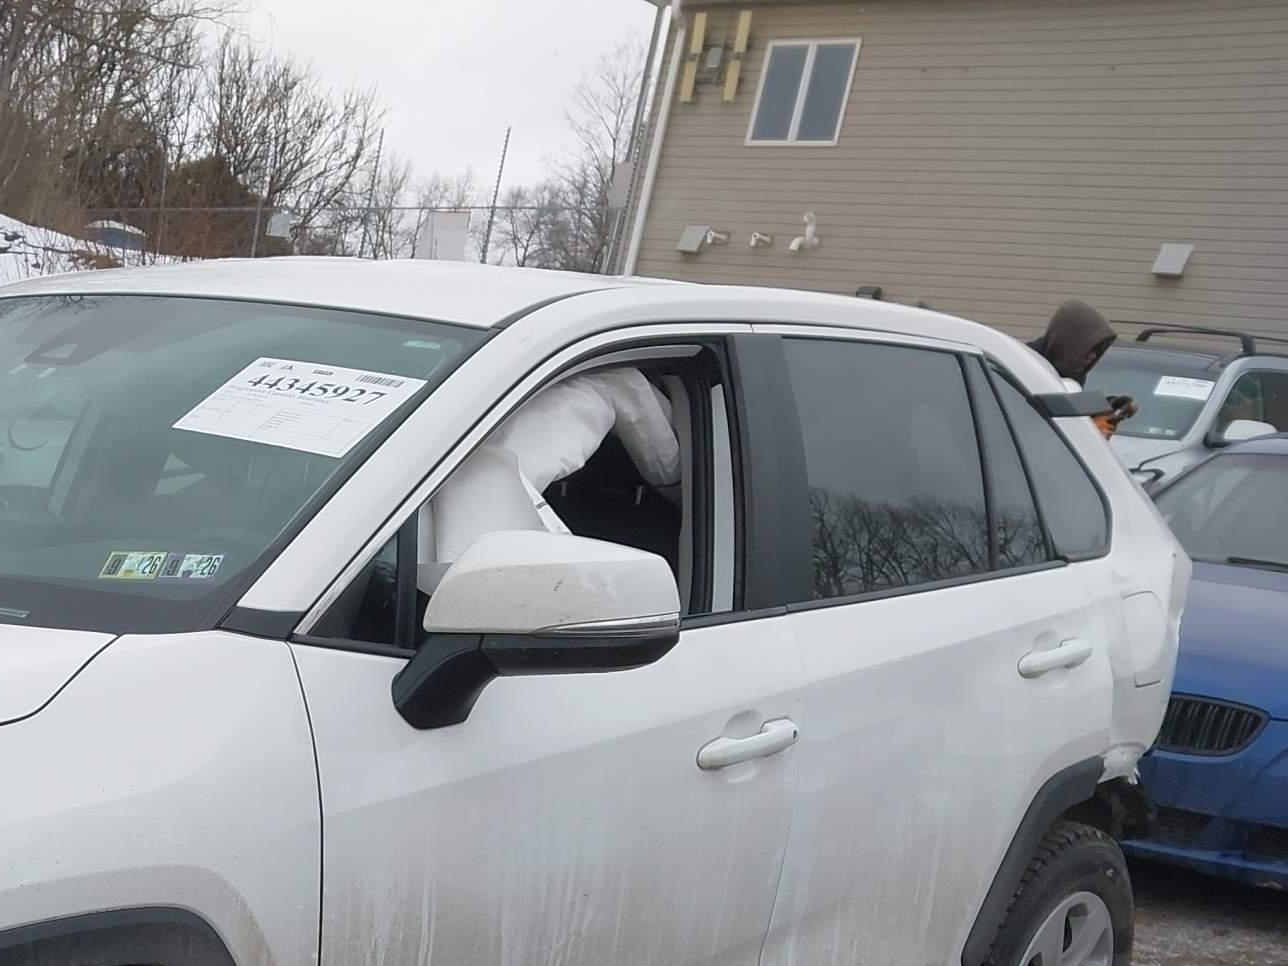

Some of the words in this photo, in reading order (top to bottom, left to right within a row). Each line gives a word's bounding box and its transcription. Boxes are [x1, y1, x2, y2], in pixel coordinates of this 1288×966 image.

[247, 373, 388, 406] 44345927
[141, 555, 162, 575] 26
[199, 556, 221, 576] 26
